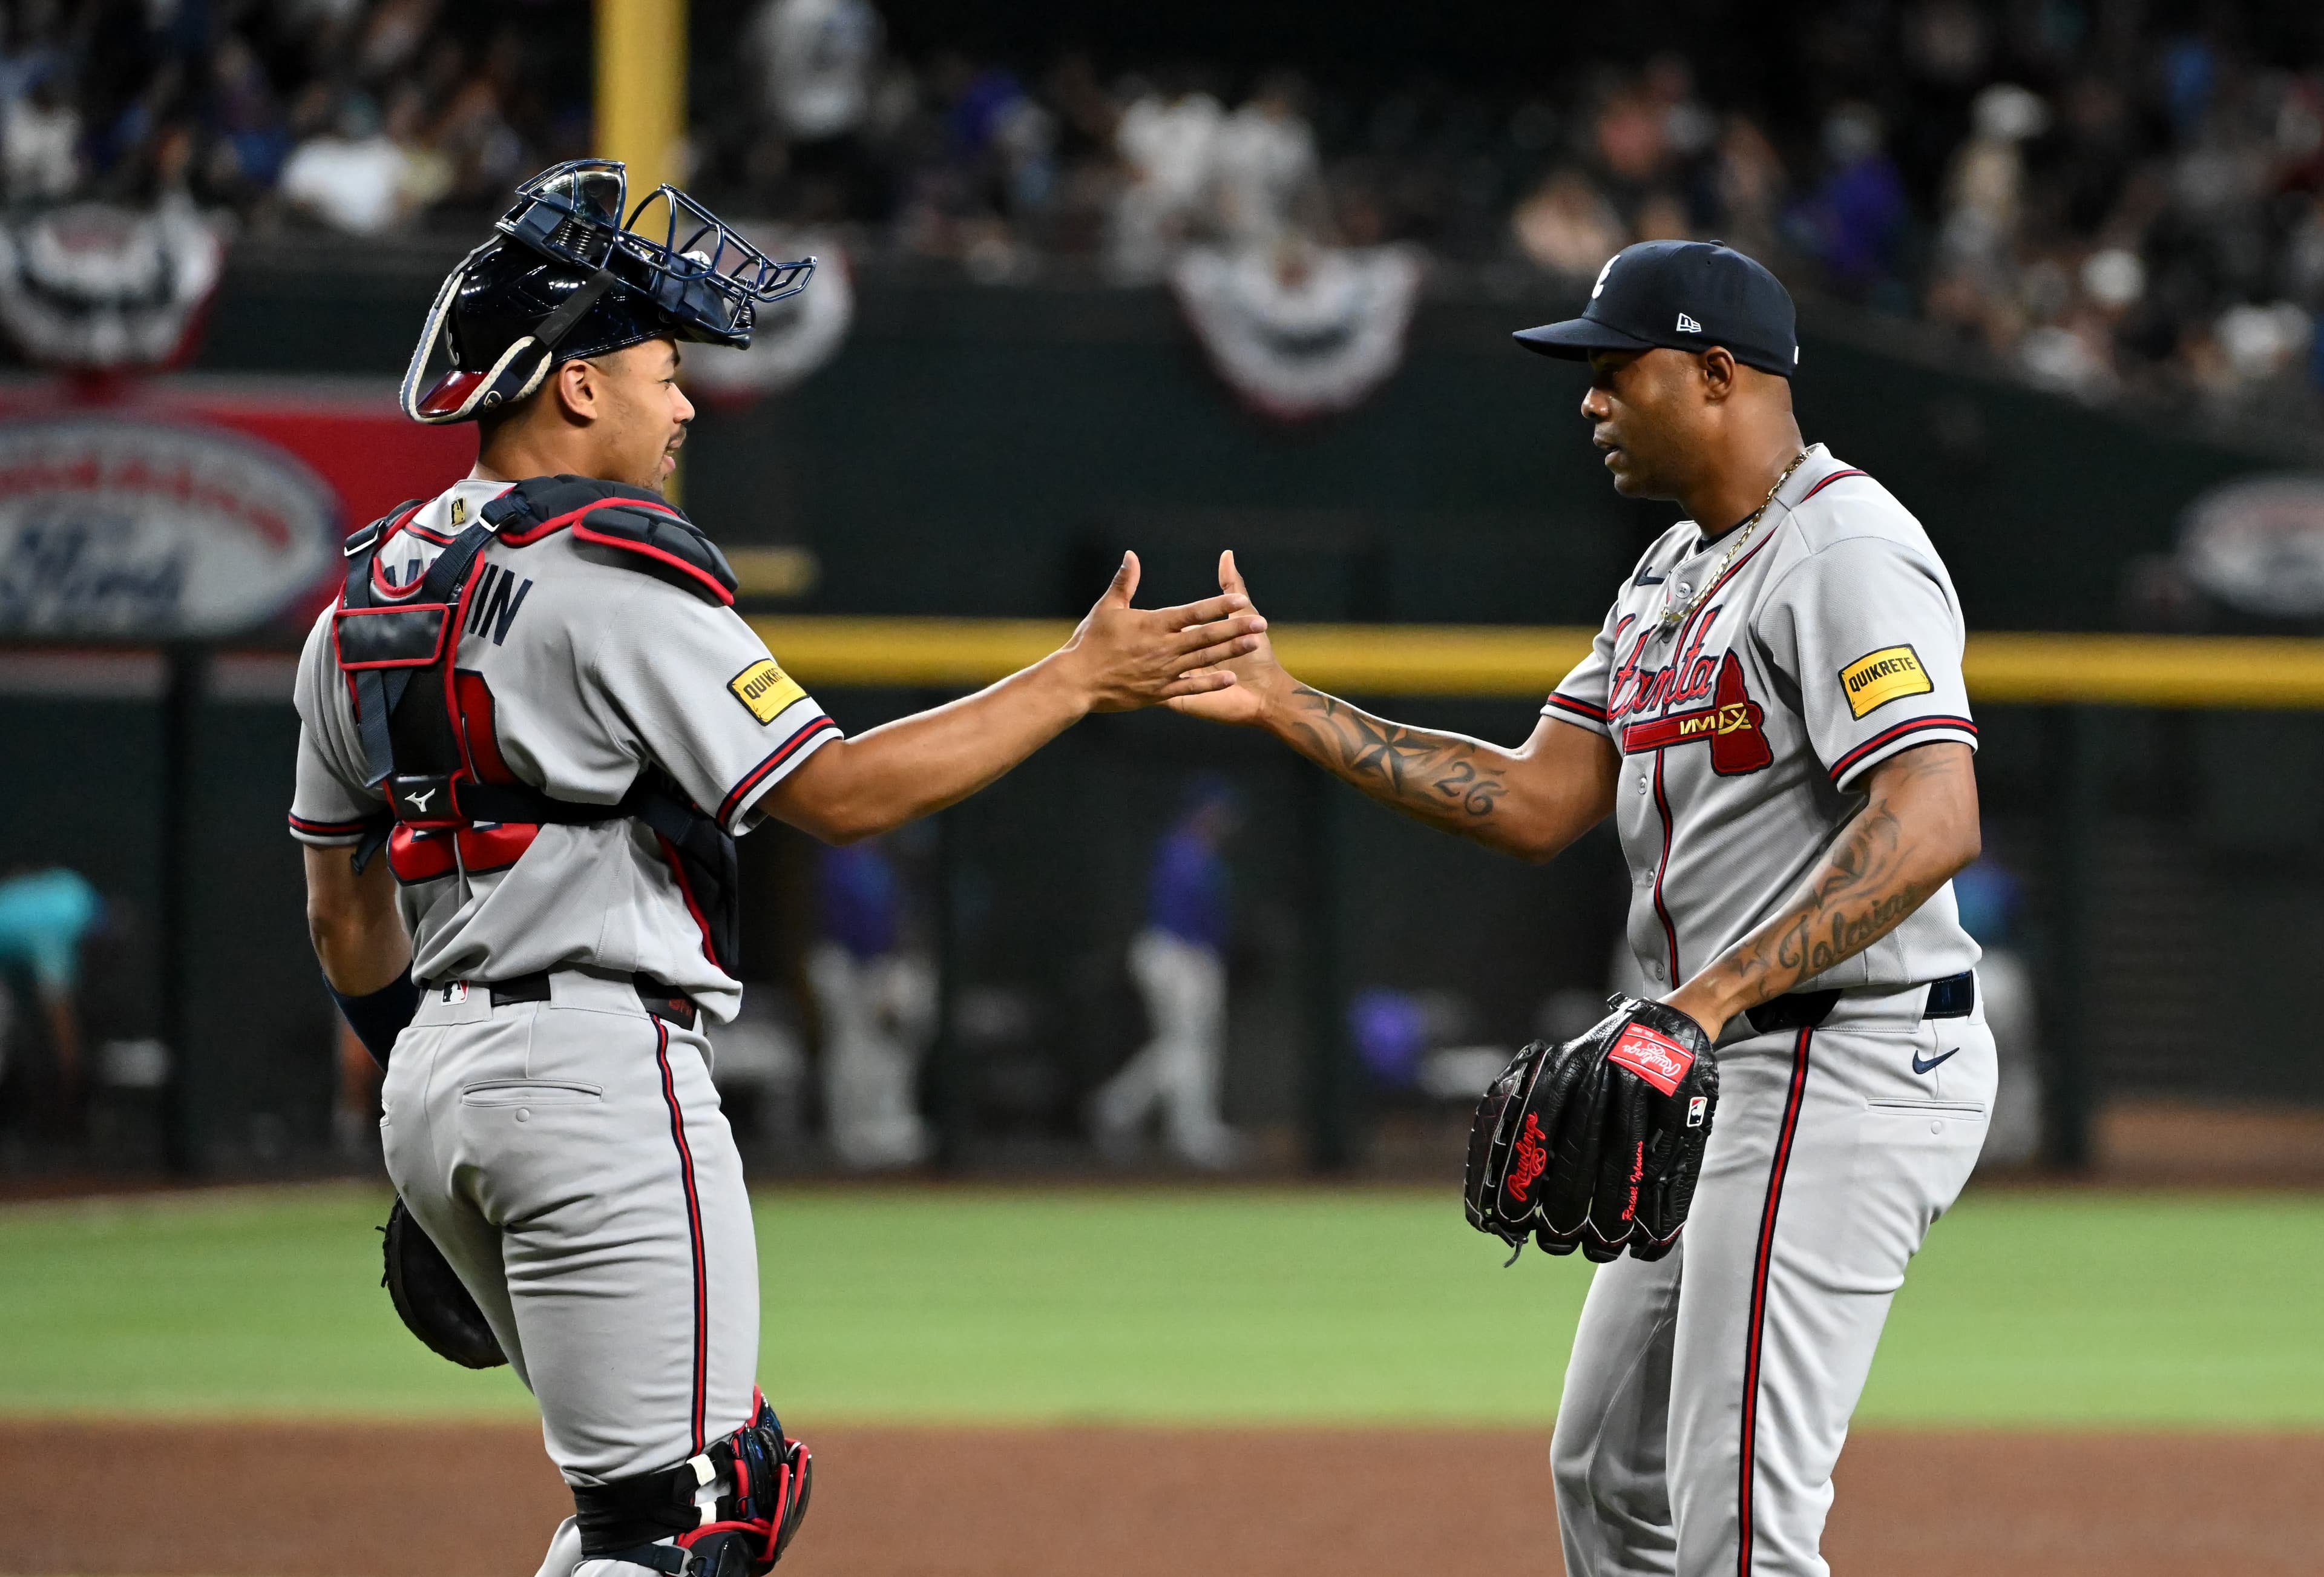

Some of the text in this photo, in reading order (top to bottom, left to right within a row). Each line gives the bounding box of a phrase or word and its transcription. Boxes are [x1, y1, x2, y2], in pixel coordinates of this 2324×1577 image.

[743, 668, 784, 700] QUIKRE
[1607, 604, 1720, 725] tanta
[1848, 657, 1916, 693] QUIKRETE
[1433, 761, 1509, 816] 26
[1622, 1041, 1681, 1076] Rawlings
[1508, 1111, 1546, 1202] Rawlings
[1630, 1141, 1644, 1182] Iglesias
